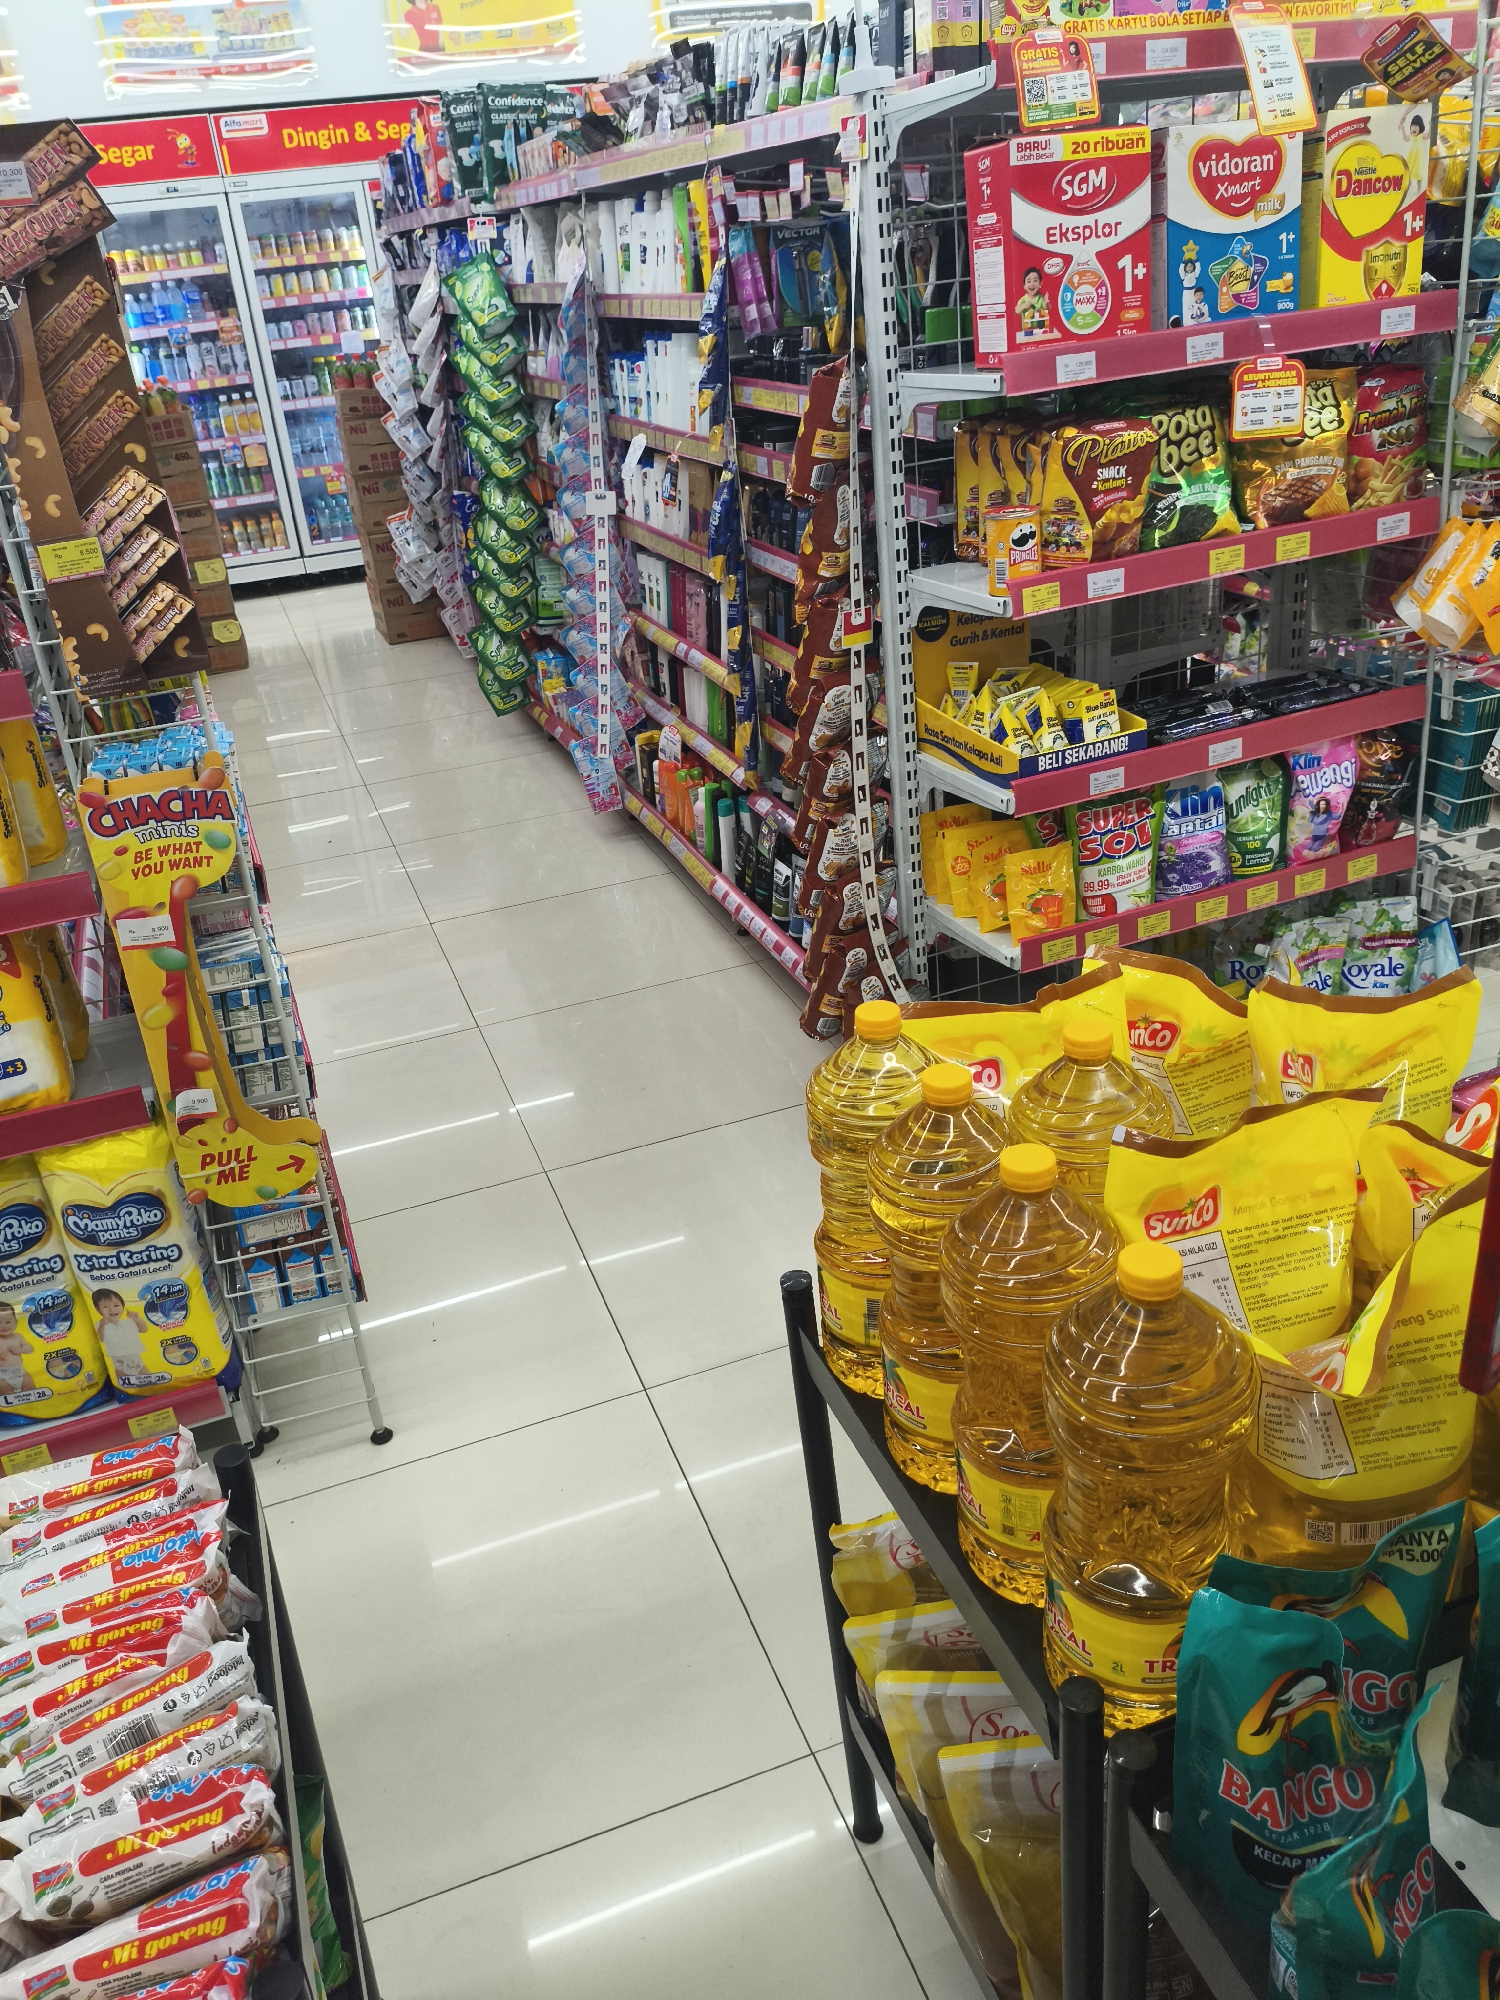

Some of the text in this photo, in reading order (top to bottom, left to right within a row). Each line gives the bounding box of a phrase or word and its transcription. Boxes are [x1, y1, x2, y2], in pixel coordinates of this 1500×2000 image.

[1064, 11, 1221, 34] GRATIS KARTU BOLA SETIAP
[1020, 47, 1058, 60] GRATIS
[1386, 43, 1445, 87] SERVICE
[1387, 42, 1426, 75] SELF
[488, 95, 544, 107] Confidence
[282, 119, 411, 150] Dingin & Seg
[1016, 136, 1146, 154] BARU! 20 ribuan
[95, 144, 155, 167] Segar
[978, 157, 991, 172] SGM
[1016, 152, 1054, 162] Lebih Besar
[1198, 153, 1274, 178] vidoran
[1353, 165, 1378, 176] Nestlé
[1061, 166, 1107, 201] SGM
[1214, 178, 1262, 200] Xmart
[1335, 168, 1404, 200] Dancow
[1256, 197, 1282, 212] milk
[777, 226, 821, 240] VECTOR
[1046, 219, 1123, 245] Eksplor
[1403, 210, 1424, 236] 1+
[1278, 231, 1296, 254] 1+
[1117, 253, 1147, 293] 1+
[1277, 301, 1295, 311] 900g
[1243, 370, 1297, 381] KEUNTUNGAN
[349, 421, 368, 436] Nü
[1353, 398, 1407, 437] French
[1063, 427, 1159, 477] Piattos
[1160, 430, 1217, 472] bee
[1096, 465, 1128, 480] SNACK
[1275, 457, 1332, 475] SAPI PANGGANG
[108, 480, 132, 508] CHUNKY
[361, 481, 380, 496] Nü
[1097, 478, 1126, 491] Kentang
[124, 494, 149, 522] CHUNKY
[123, 534, 147, 561] CHUNKY
[1010, 546, 1038, 565] PRINGLES
[138, 548, 162, 574] CHUNKY
[138, 593, 161, 618] CHUNKY
[156, 605, 180, 631] CHUNKY
[918, 616, 948, 628] KALSIUM
[950, 623, 1025, 648] Gurih & Kental
[1085, 699, 1115, 714] Blue Band
[924, 724, 1003, 767] Rasa Santan Kelapa Asli
[1038, 736, 1129, 771] BELI SEKARANG!
[1291, 753, 1321, 771] Klin
[88, 789, 236, 838] CHACHA
[1165, 784, 1224, 820] Klin
[938, 815, 969, 830] Stella
[1075, 798, 1155, 830] SUPER
[136, 823, 199, 845] minis
[1079, 823, 1154, 863] SOL
[1246, 840, 1261, 849] 100
[134, 841, 203, 864] BE WHAT
[1245, 856, 1270, 866] Lemak
[131, 855, 213, 880] YOU WANT
[1021, 860, 1053, 876] Stella
[1098, 856, 1146, 878] KARBOL WANGI
[1083, 879, 1116, 893] 99.99%
[1364, 938, 1383, 948] WANGI
[1341, 955, 1405, 985] Royale
[1372, 980, 1389, 989] Klin
[201, 1147, 258, 1171] PULL
[216, 1165, 251, 1186] ME
[66, 1206, 162, 1236] MamyPoko
[1147, 1196, 1214, 1237] SunCo
[98, 1228, 138, 1243] pants
[74, 1245, 180, 1273] X-tra Kering
[1189, 1241, 1218, 1256] NILAI GIZI
[1, 1256, 63, 1281] Kering
[90, 1263, 173, 1281] Bebas Gatal Lecet
[153, 1284, 169, 1297] 14
[1426, 1303, 1461, 1321] Sawit
[161, 1339, 173, 1347] 2X
[121, 1376, 136, 1386] XL
[156, 1374, 167, 1382] 26
[63, 1467, 154, 1498] Mi goreng
[64, 1487, 157, 1527] Mi goreng
[85, 1570, 186, 1612] Mi goreng
[62, 1616, 164, 1653] Mi goreng
[1111, 1661, 1126, 1674] 2L
[85, 1665, 188, 1728] Mi goreng
[53, 1711, 72, 1723] CARA
[107, 1717, 215, 1779] Mi goreng
[1218, 1758, 1376, 1832] BANGO
[106, 1805, 224, 1862] Mi goreng
[1264, 1822, 1331, 1844] SEJAK 1928
[1254, 1844, 1302, 1869] KECAP
[99, 1871, 117, 1885] CARA
[103, 1914, 227, 1969] Mi goreng
